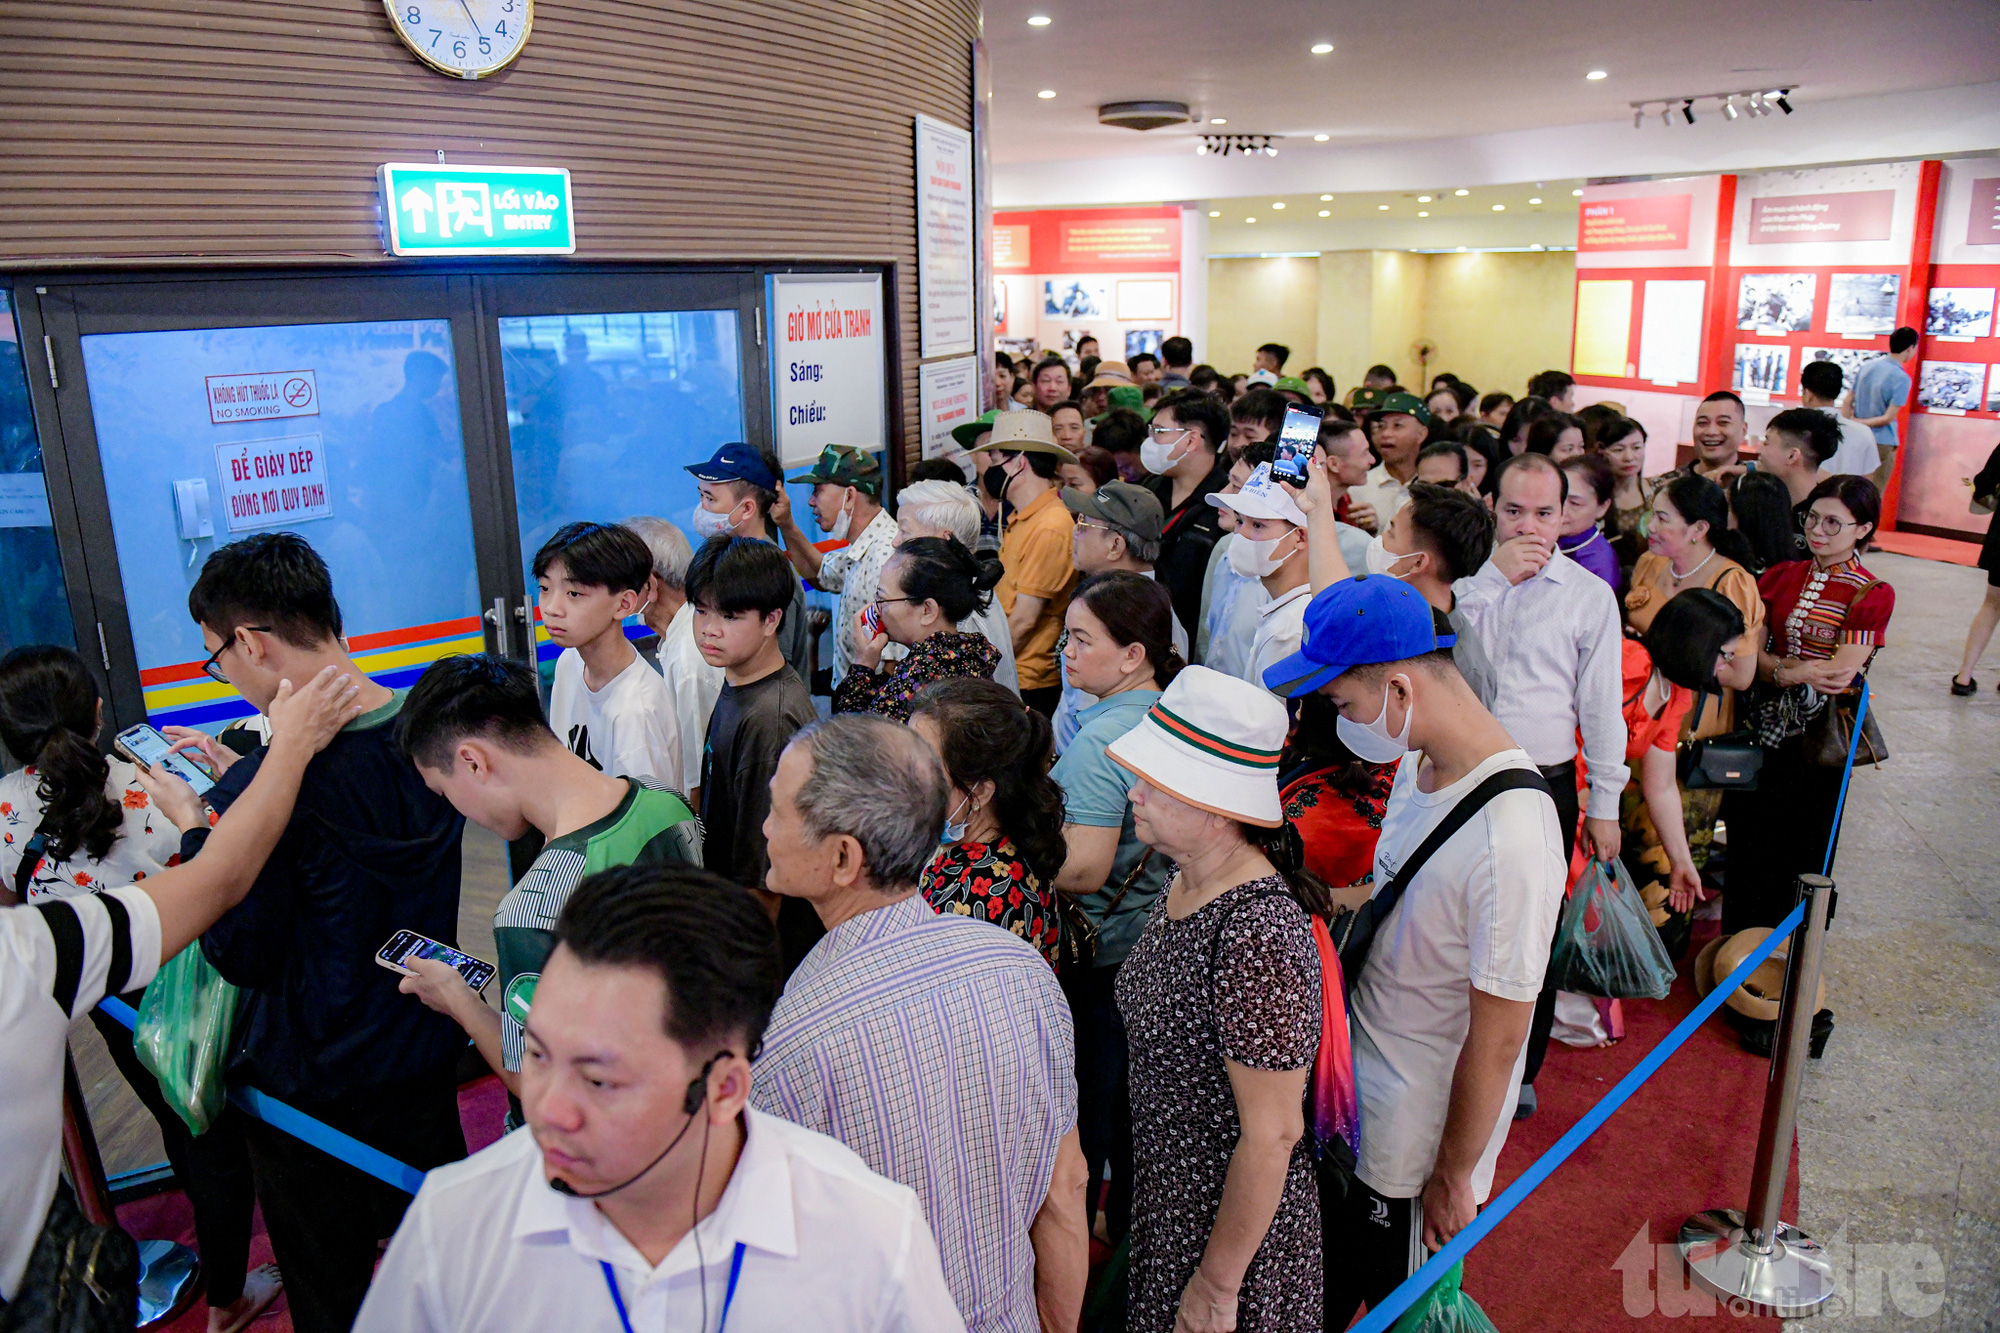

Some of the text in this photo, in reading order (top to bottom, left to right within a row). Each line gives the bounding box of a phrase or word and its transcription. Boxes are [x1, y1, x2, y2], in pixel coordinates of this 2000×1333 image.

[407, 6, 421, 25] 8
[502, 0, 514, 12] 3
[495, 19, 508, 37] 4
[428, 29, 443, 48] 7
[479, 36, 492, 55] 5
[453, 41, 466, 59] 6
[493, 188, 559, 210] LỐI VÀO
[503, 214, 553, 230] ENTRY
[788, 299, 871, 342] GIỜ MỞ CỬA TRANH
[790, 360, 823, 382] Sáng:
[213, 378, 279, 404] KHÔNG HÚT THUỐC LÁ
[216, 405, 281, 418] NO SMOKING
[790, 400, 826, 425] Chiều:
[231, 446, 313, 482] ĐỂ GIÀY DÉP
[231, 483, 325, 518] ĐÚNG NƠI QUY ĐỊNH
[1368, 1213, 1391, 1228] Jeep
